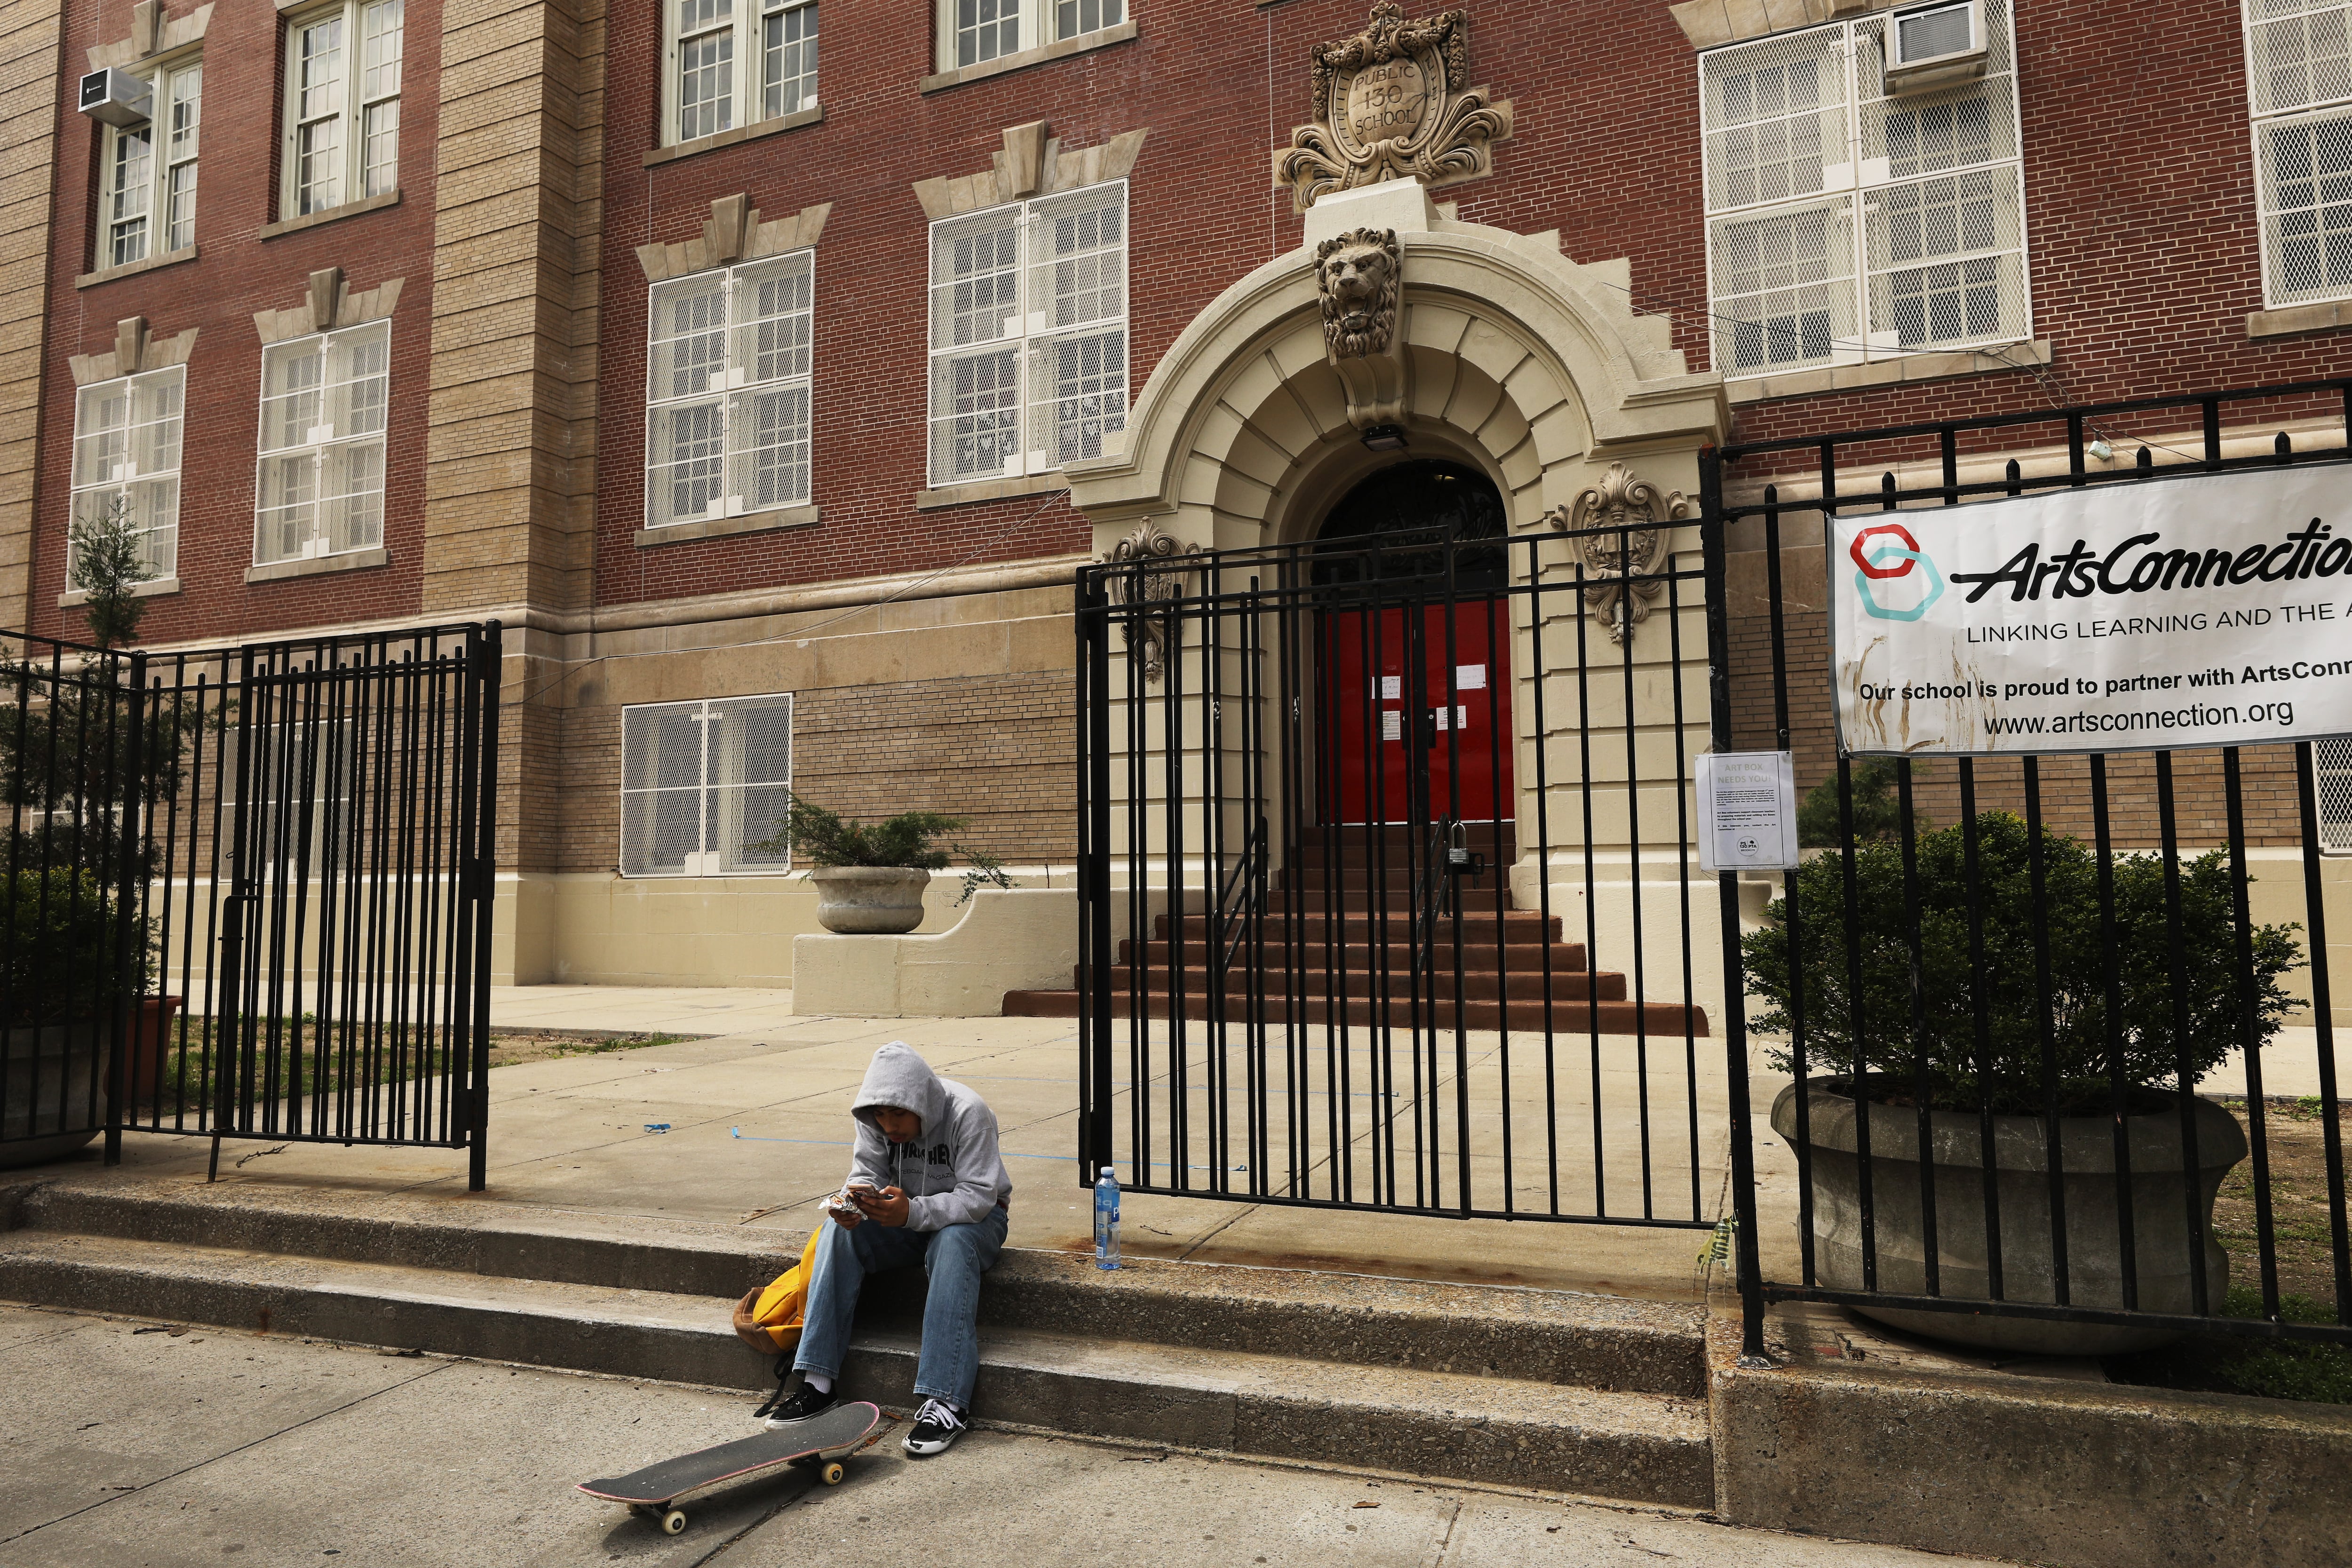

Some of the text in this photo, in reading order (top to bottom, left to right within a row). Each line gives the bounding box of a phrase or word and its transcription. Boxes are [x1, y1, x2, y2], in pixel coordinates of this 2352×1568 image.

[1354, 66, 1415, 91] PUBLIC
[1365, 85, 1402, 110] 130
[1355, 110, 1417, 135] SCHOOL
[1968, 623, 2068, 643] LINKING
[2078, 613, 2207, 638] LEARNING
[2216, 608, 2272, 629] AND
[2280, 603, 2335, 623] THE
[1860, 684, 1895, 700] Our
[1901, 681, 1971, 700] school
[1979, 681, 1997, 697] is
[2005, 677, 2069, 701] proud
[2076, 677, 2098, 694] to
[2106, 674, 2182, 697] partner
[2188, 668, 2234, 687] with
[1984, 701, 2294, 734] www.artsconnection.org
